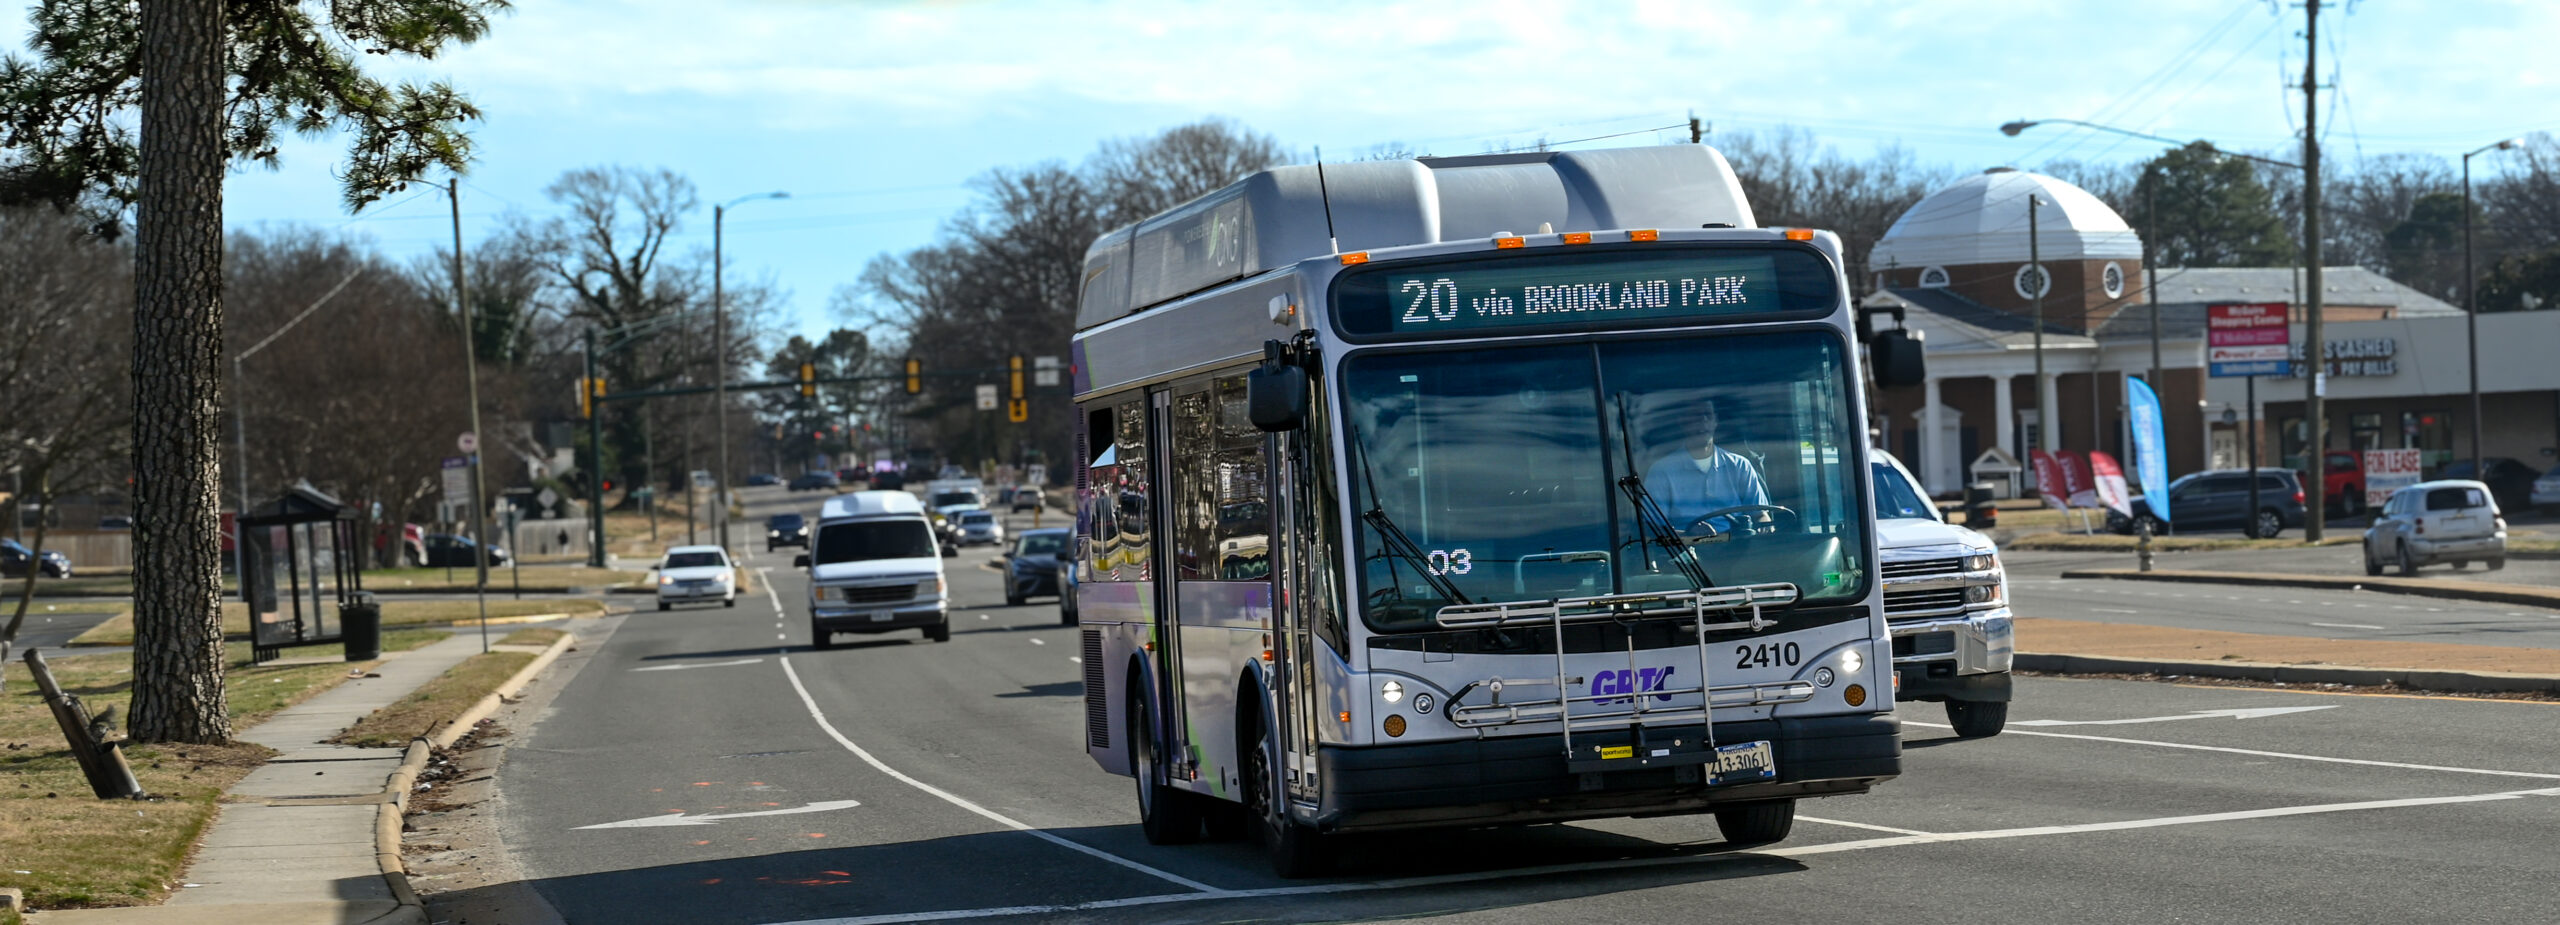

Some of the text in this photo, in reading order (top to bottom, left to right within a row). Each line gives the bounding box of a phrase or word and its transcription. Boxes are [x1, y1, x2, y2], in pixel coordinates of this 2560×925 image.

[1217, 216, 1238, 267] CNG
[1401, 276, 1747, 323] 20 via BROOKLAND PARK
[2336, 338, 2394, 358] CASHED
[2341, 361, 2363, 376] PAY
[2364, 360, 2395, 375] BILLS
[2367, 451, 2420, 473] FOR LEASE
[1428, 549, 1471, 576] 03
[1736, 641, 1801, 669] 2410
[1591, 666, 1675, 705] GRTC
